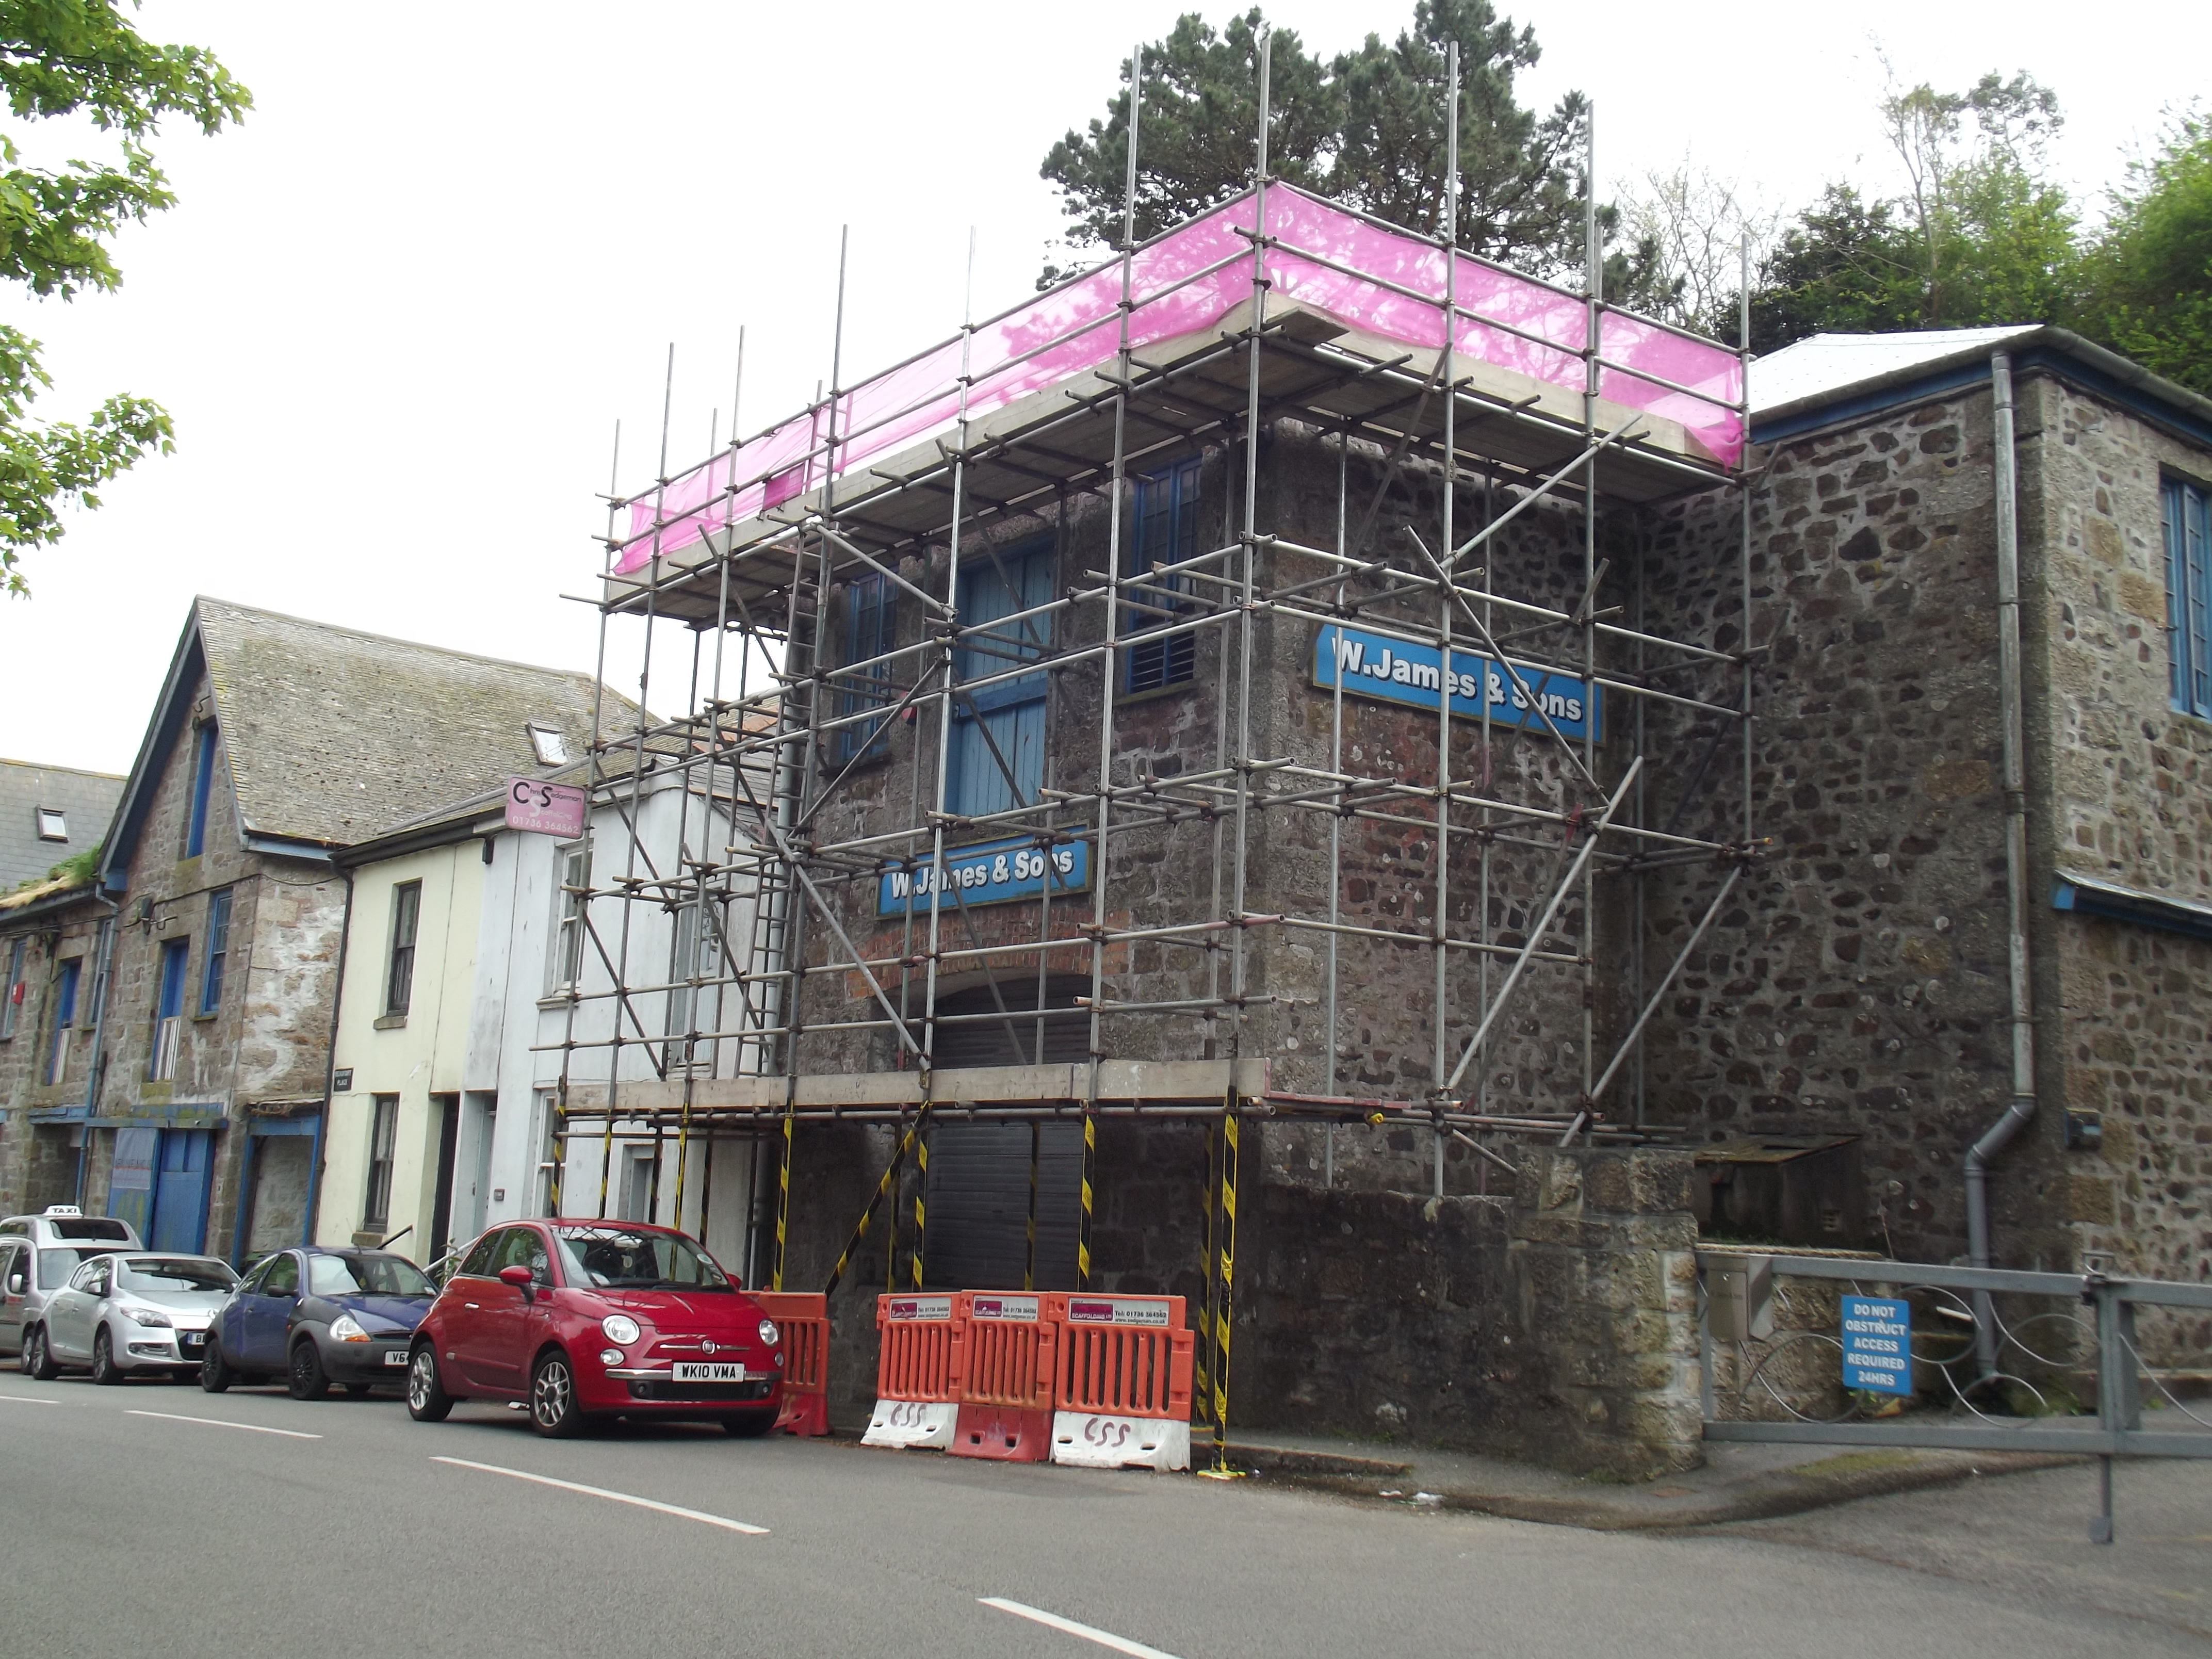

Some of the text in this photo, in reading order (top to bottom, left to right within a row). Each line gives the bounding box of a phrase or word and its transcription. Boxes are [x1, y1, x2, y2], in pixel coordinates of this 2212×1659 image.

[1331, 637, 1582, 721] W.James & Sons
[512, 816, 579, 834] 01736 364562
[992, 855, 1010, 883] &
[1014, 851, 1074, 879] Sos
[1854, 1304, 1896, 1318] DO NOT
[1845, 1319, 1907, 1337] OBSTRUCT
[1853, 1337, 1899, 1353] ACCESS
[682, 1364, 737, 1378] WK10 VMA
[1847, 1353, 1906, 1371] REQUIRED
[1858, 1370, 1896, 1387] 24HRS
[890, 1403, 927, 1428] CSS
[1084, 1417, 1132, 1448] CSS
